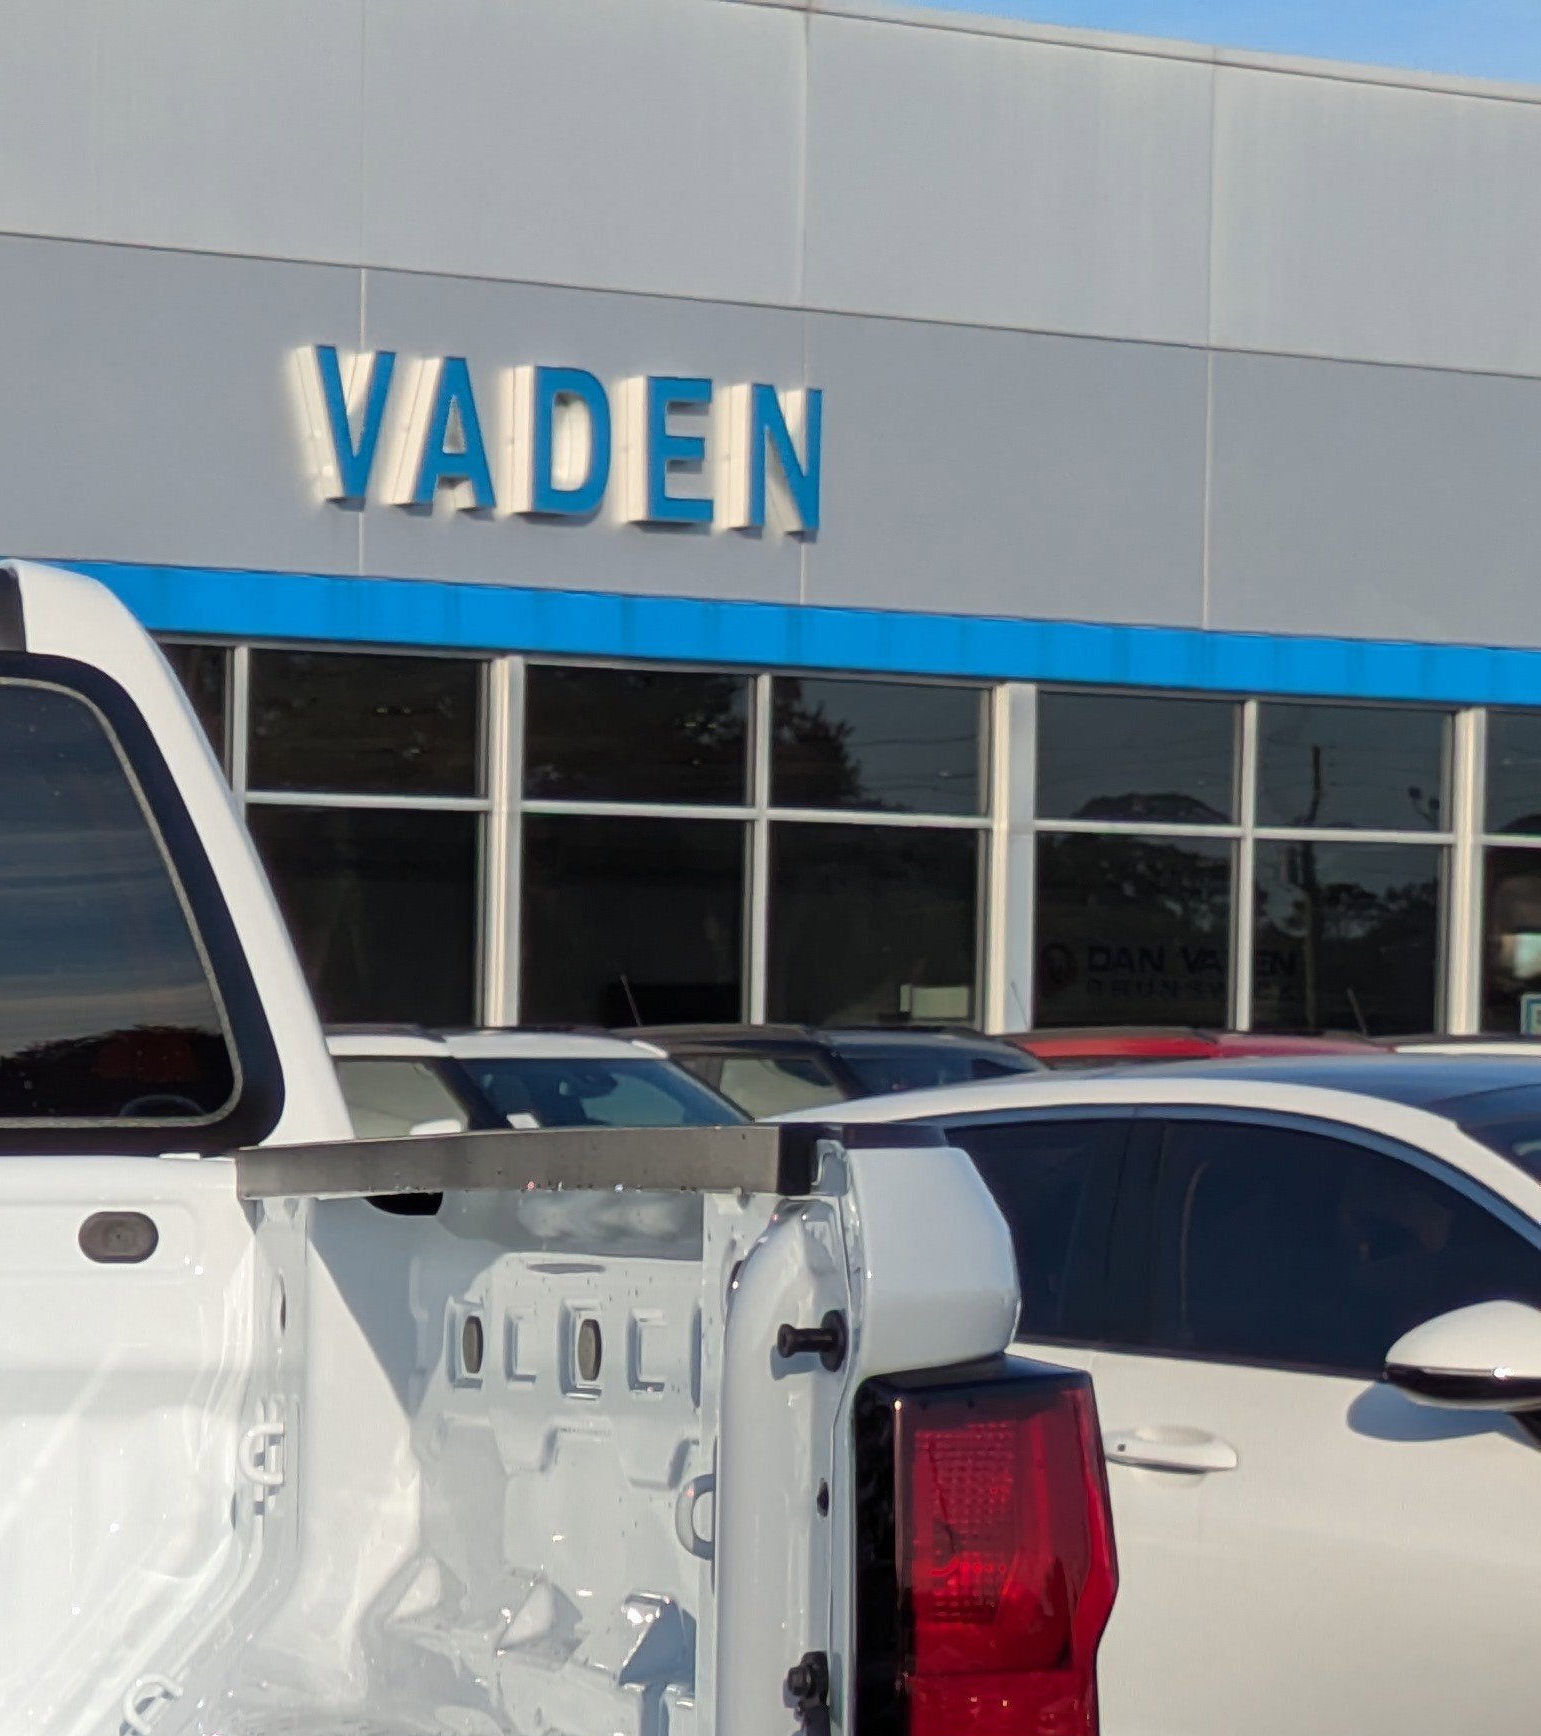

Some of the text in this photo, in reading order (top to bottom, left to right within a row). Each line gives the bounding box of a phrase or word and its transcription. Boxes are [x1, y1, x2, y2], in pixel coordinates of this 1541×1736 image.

[293, 344, 824, 534] VADEN
[1086, 944, 1297, 977] DAN VAEN
